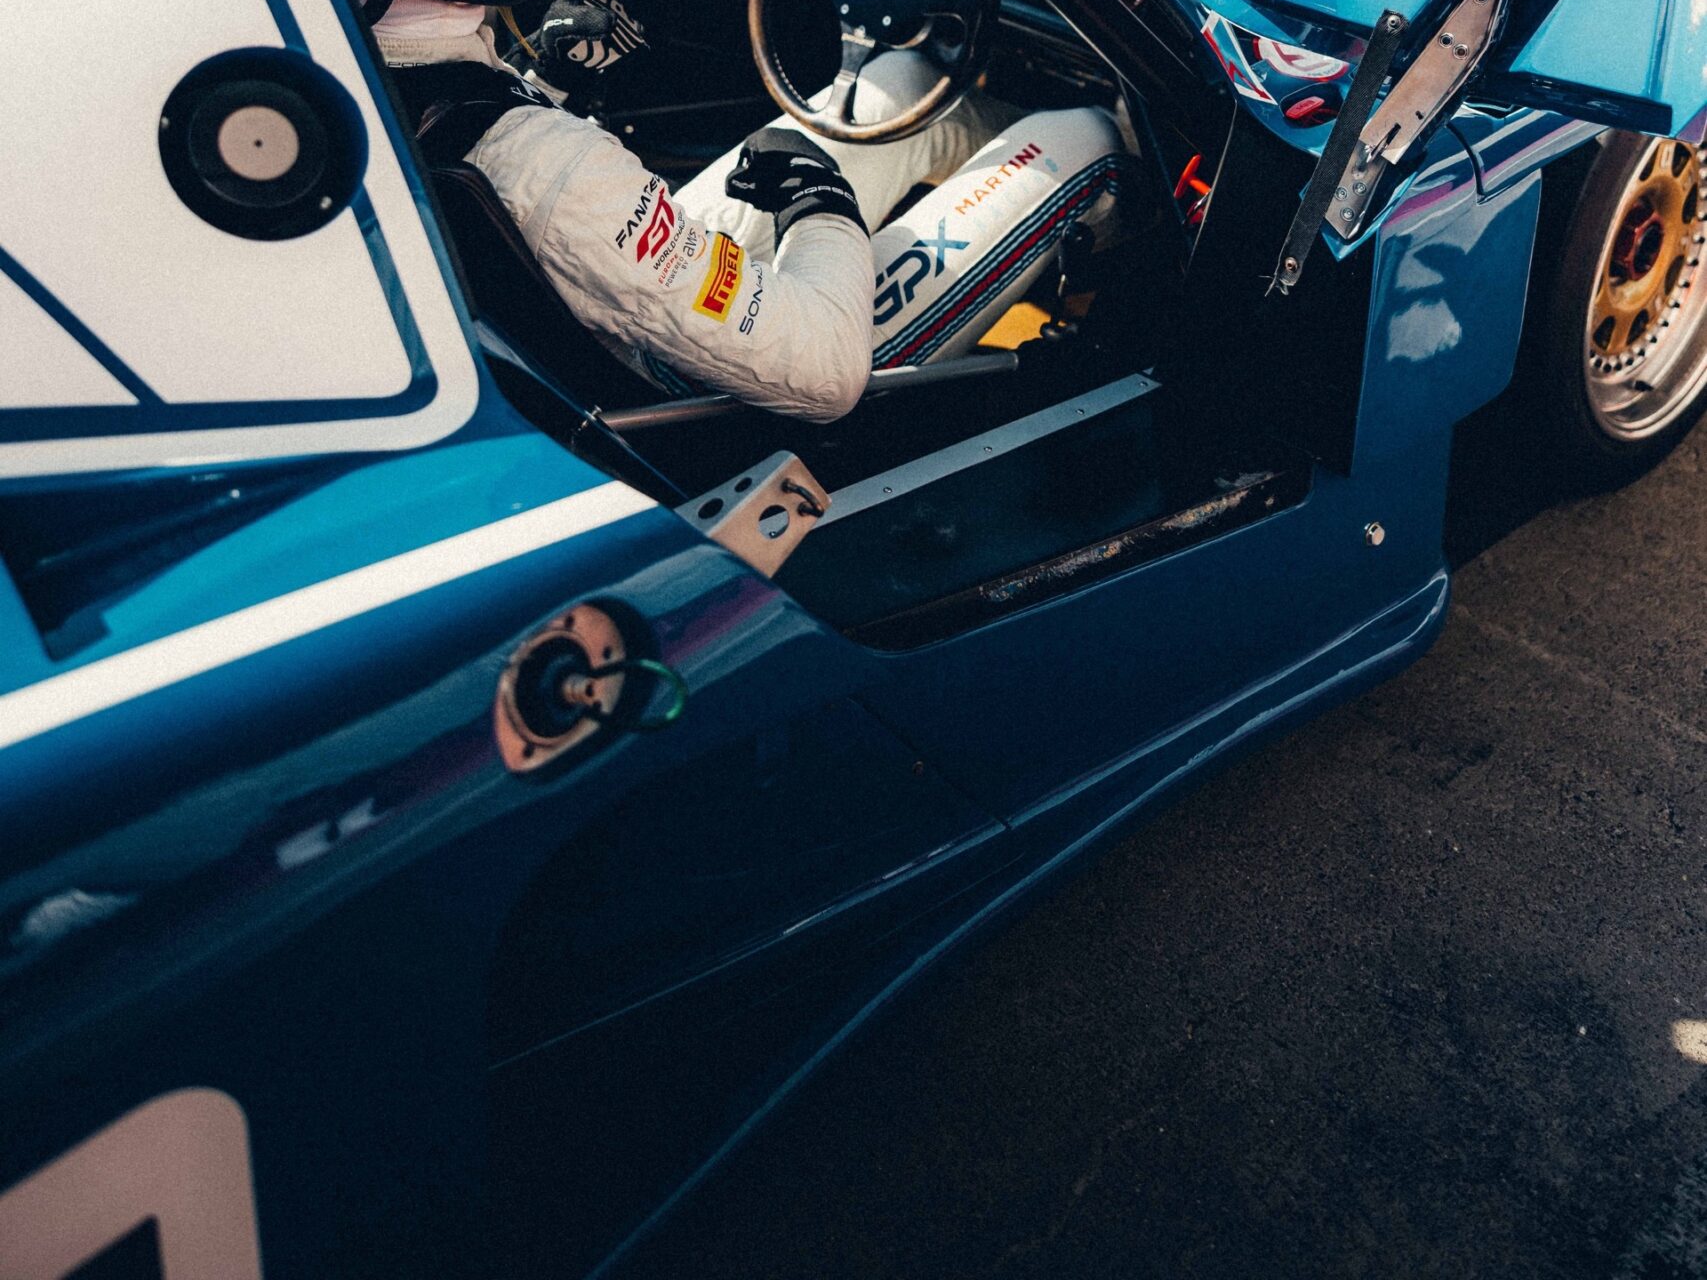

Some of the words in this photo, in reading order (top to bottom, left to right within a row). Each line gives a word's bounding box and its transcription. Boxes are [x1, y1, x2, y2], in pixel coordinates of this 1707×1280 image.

[955, 143, 1043, 215] MARTINI
[653, 242, 676, 270] WORLD
[683, 228, 698, 257] aws
[659, 253, 679, 284] EUROPE
[666, 256, 685, 288] POWERED
[682, 260, 689, 270] BY
[873, 216, 971, 326] GPX
